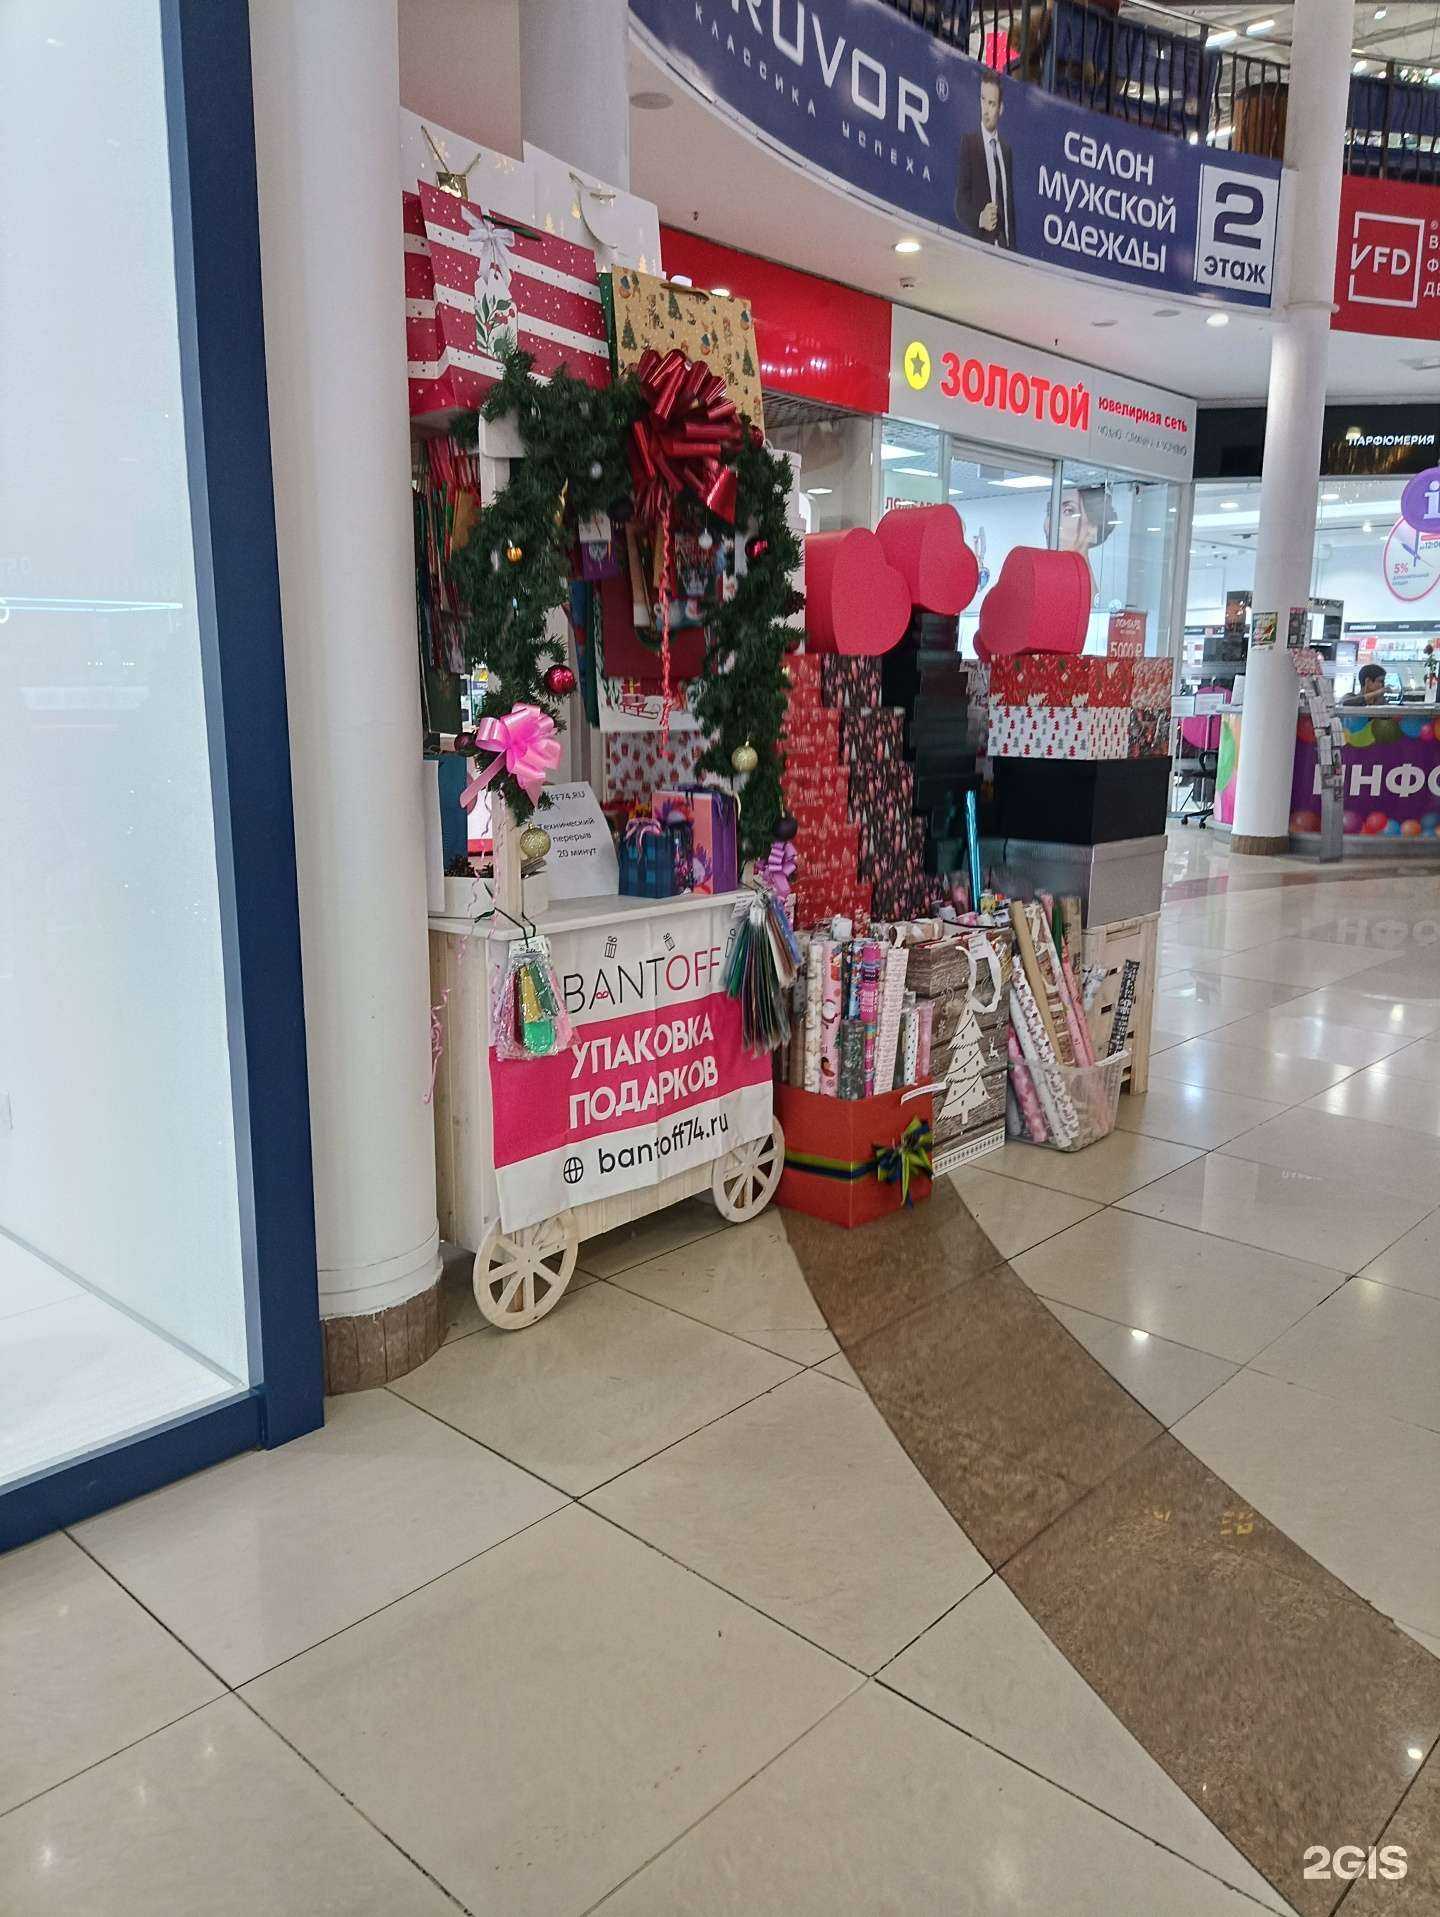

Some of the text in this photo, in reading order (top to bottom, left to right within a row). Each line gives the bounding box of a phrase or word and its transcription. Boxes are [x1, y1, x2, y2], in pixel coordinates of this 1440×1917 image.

[1213, 181, 1264, 249] 2
[1203, 254, 1266, 285] этаж
[939, 351, 1091, 432] ЗОЛОТОЙ
[1098, 396, 1188, 433] Ювелирная сеть
[1348, 433, 1435, 447] ПАРФЮМЕРИЯ
[537, 816, 596, 831] Технический
[552, 832, 592, 844] перерыв
[556, 847, 597, 858] 20 минут
[563, 946, 722, 1014] BANTOFF
[570, 1012, 715, 1080] УПАКОВКА
[568, 1055, 719, 1130] ПОДАРКОВ
[598, 1111, 729, 1175] bantoff74.ru
